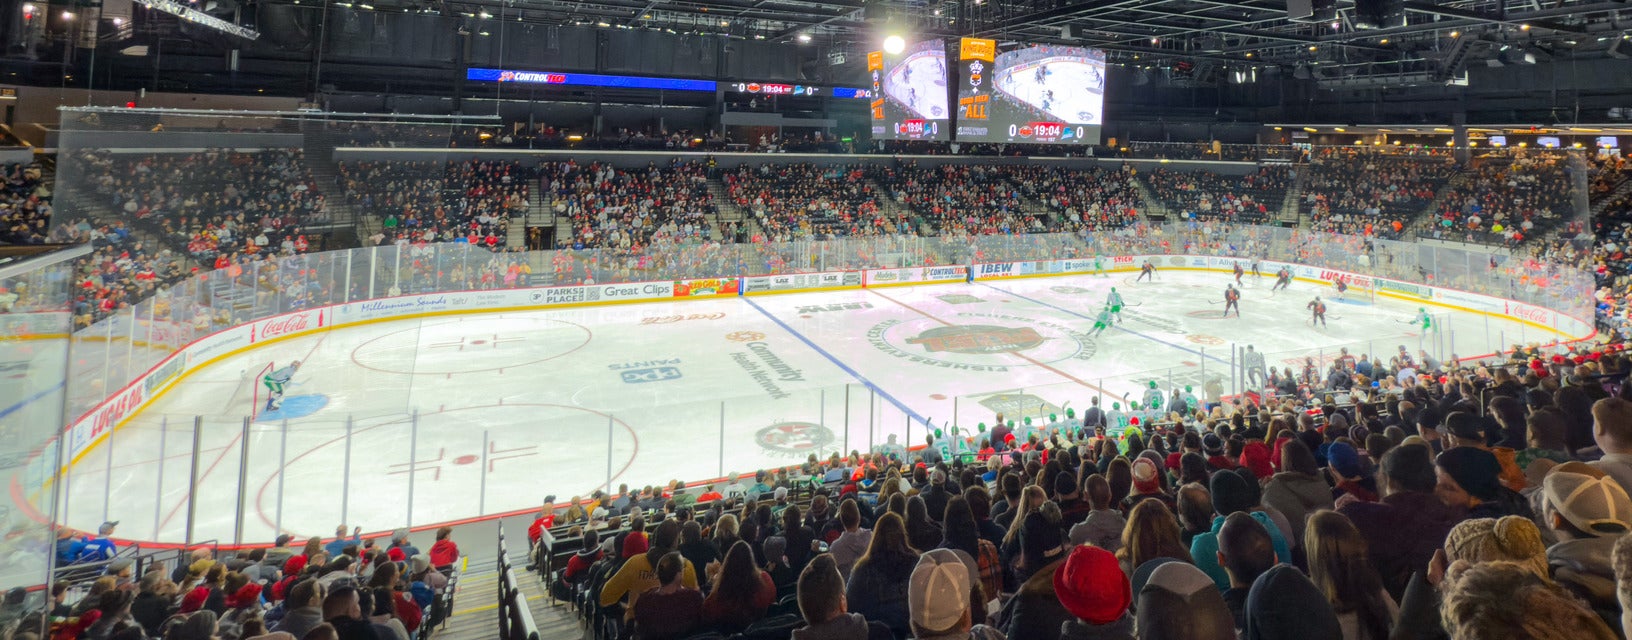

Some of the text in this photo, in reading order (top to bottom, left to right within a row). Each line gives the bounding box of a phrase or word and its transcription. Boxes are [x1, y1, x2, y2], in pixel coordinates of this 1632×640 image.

[738, 83, 745, 92] 0
[762, 85, 783, 93] 19:04
[806, 86, 813, 95] 0
[965, 104, 988, 119] ALL
[894, 122, 900, 134] 0
[932, 121, 938, 134] 0
[1009, 124, 1084, 139] 0 19:04 0
[981, 263, 1013, 274] IBEW
[604, 284, 670, 297] Great Clips
[688, 279, 721, 289] RED GOLD
[546, 288, 579, 296] PARKS
[361, 300, 414, 312] Millennium
[416, 295, 447, 306] Sounds
[546, 295, 578, 303] PLACE
[608, 358, 682, 371] PAINTS
[746, 341, 806, 382] Community
[908, 355, 1008, 372] FISHERS
[729, 351, 792, 400] Health Network
[91, 386, 142, 438] LUCAS OIL
